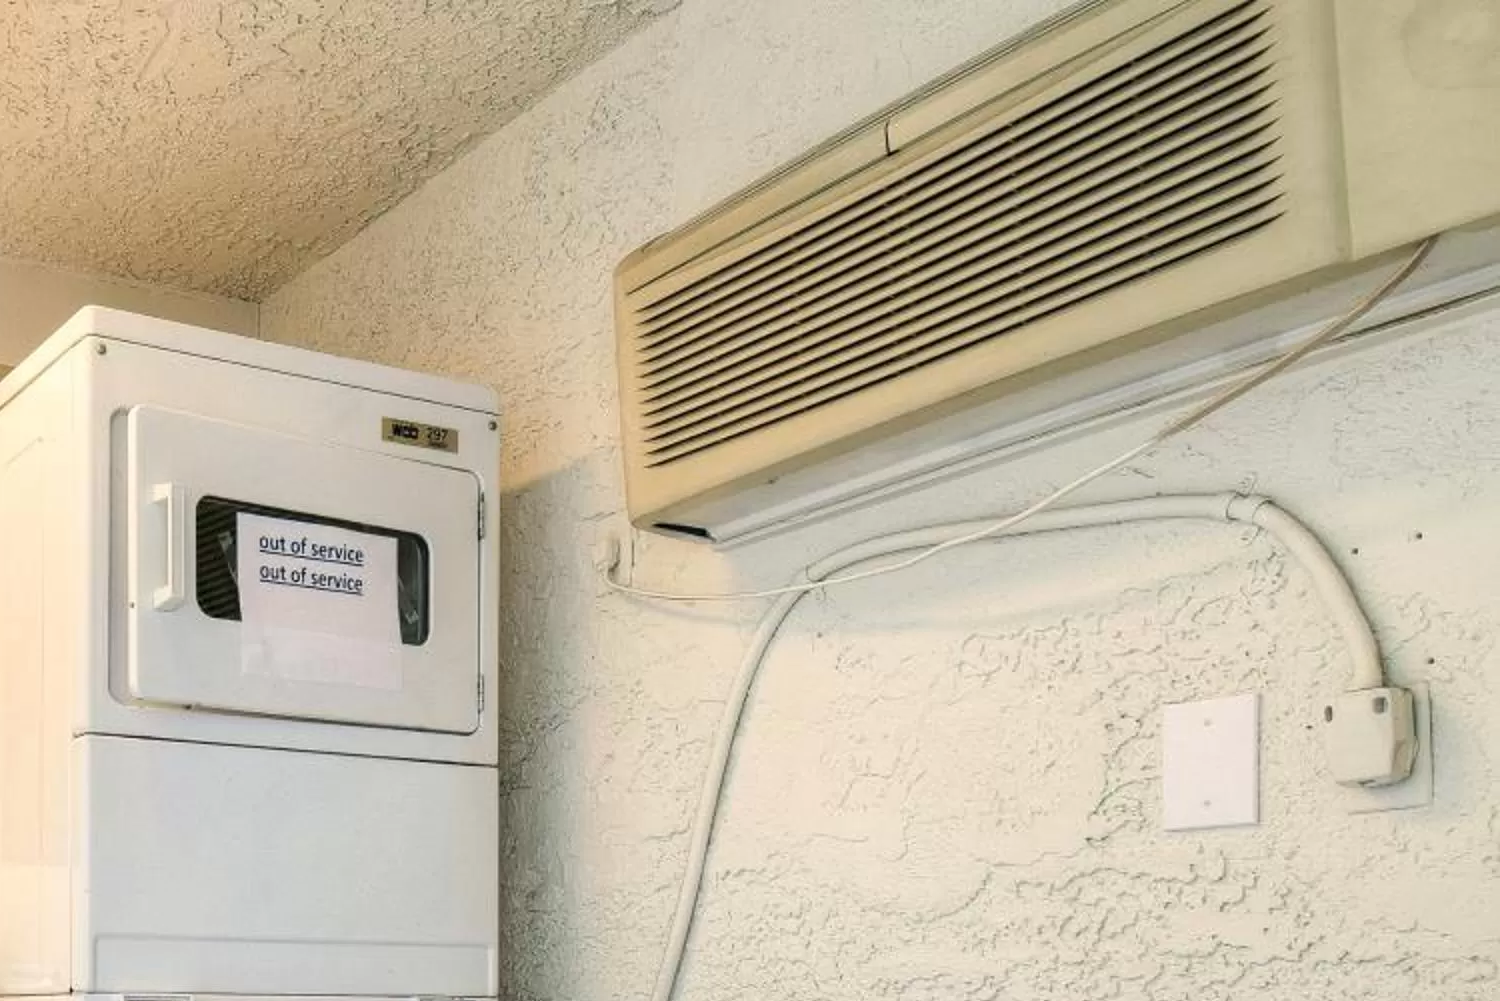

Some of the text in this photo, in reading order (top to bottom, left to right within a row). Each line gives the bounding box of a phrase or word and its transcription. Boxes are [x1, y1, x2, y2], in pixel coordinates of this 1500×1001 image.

[259, 535, 364, 563] out of service
[259, 565, 363, 592] out of service
